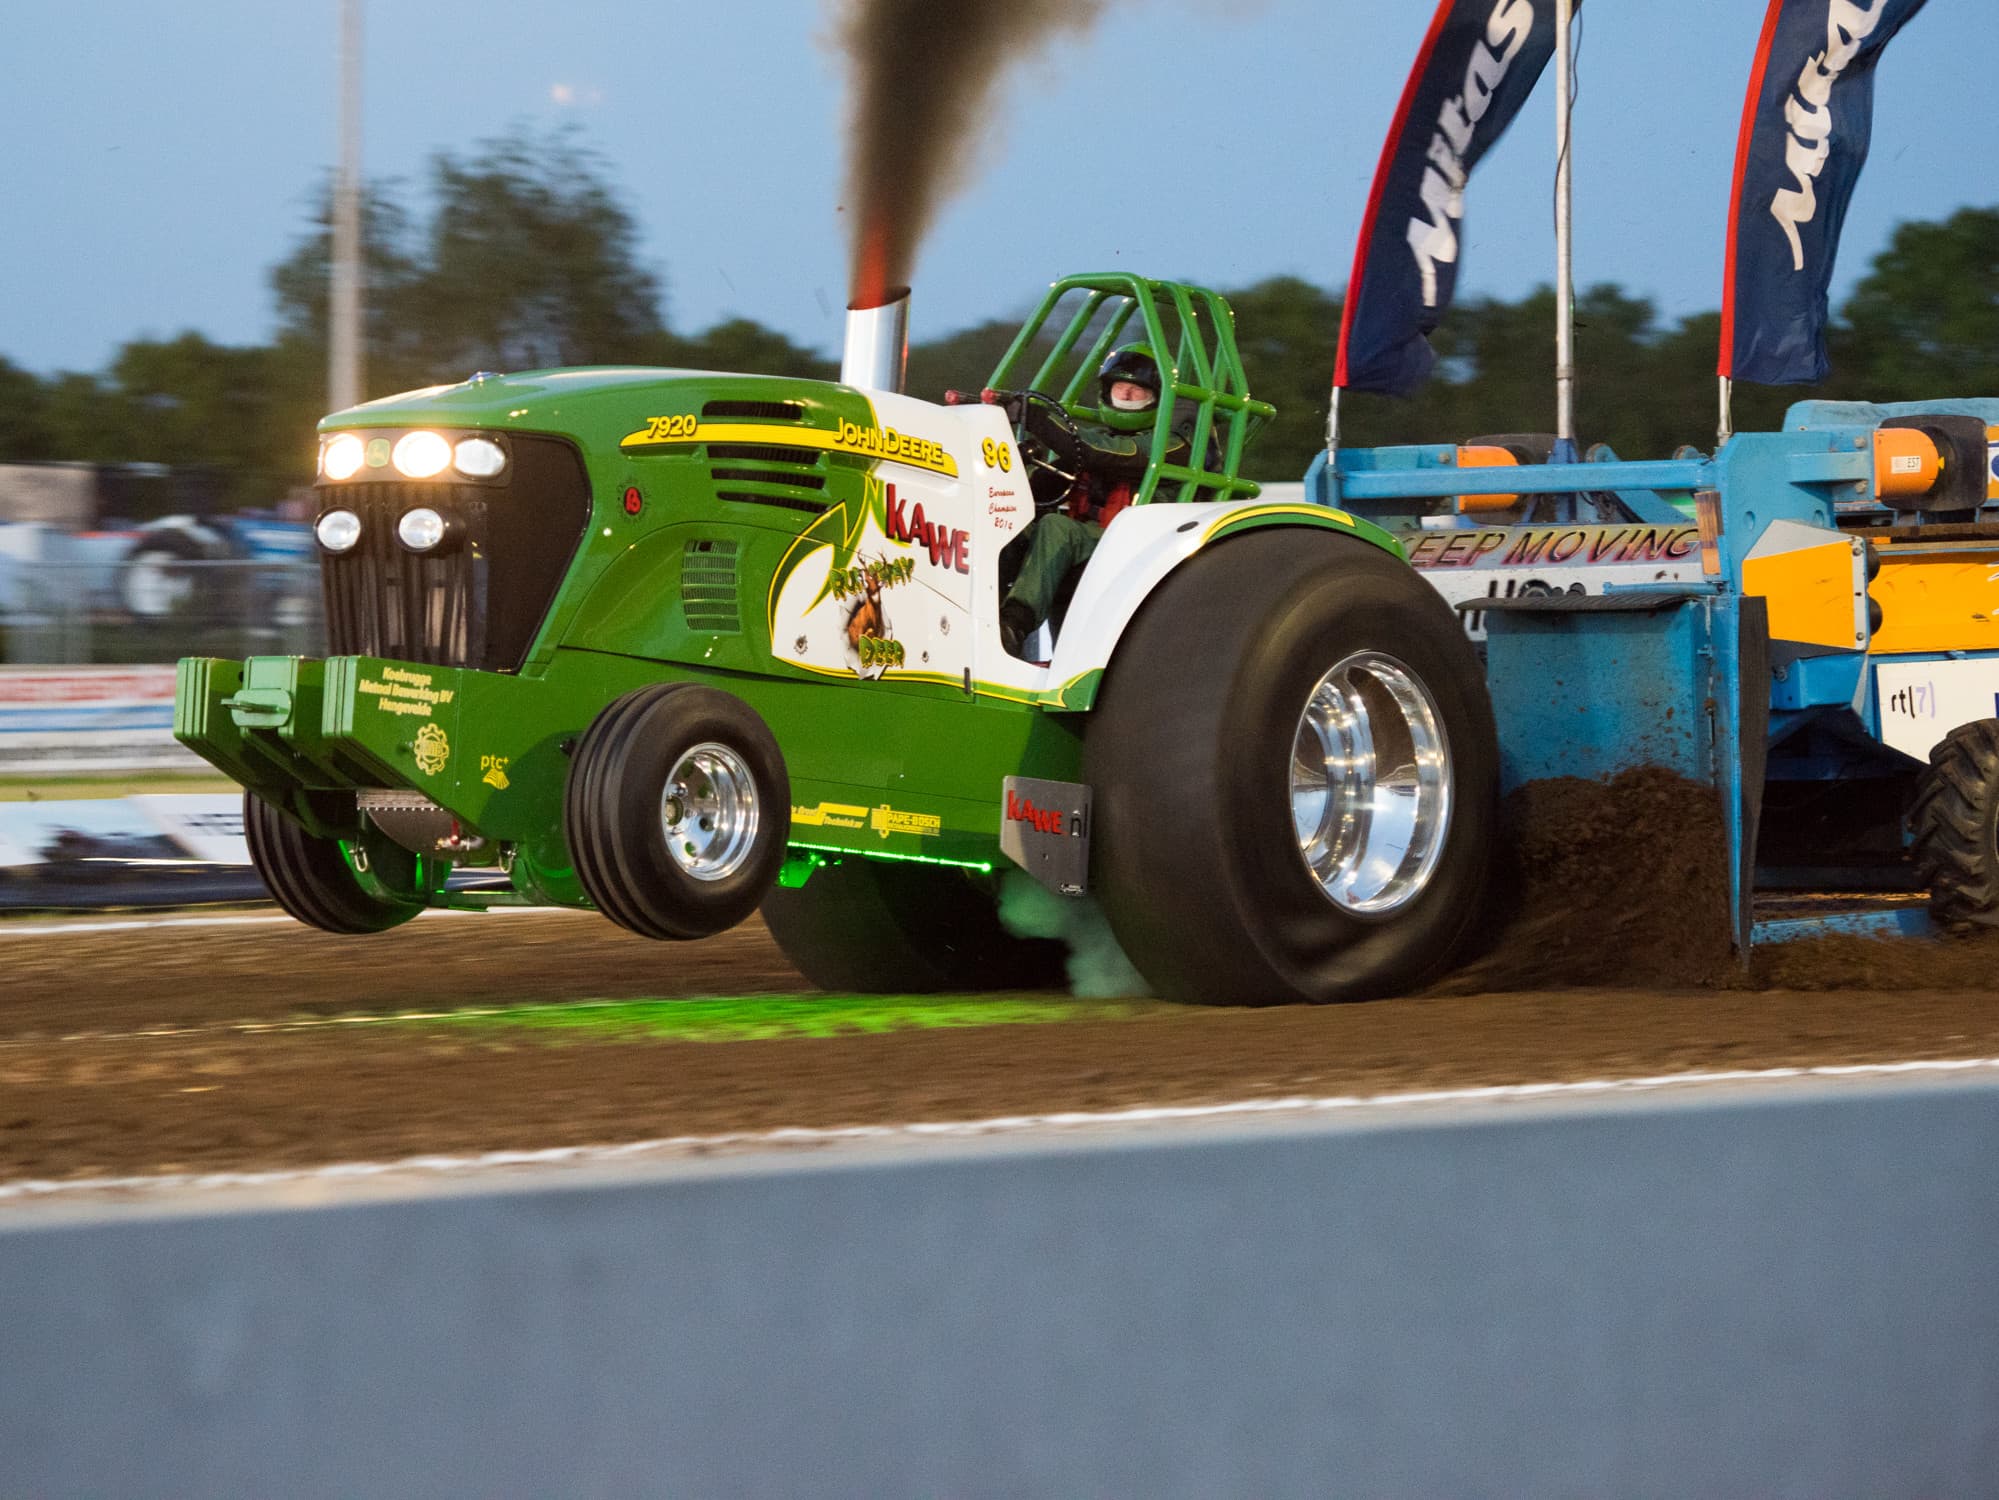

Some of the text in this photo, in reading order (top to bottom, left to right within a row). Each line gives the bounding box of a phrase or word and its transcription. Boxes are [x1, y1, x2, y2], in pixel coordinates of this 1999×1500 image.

[647, 414, 698, 439] 7920
[834, 416, 944, 466] JOHN DEERE
[982, 437, 1011, 473] 96
[1404, 527, 1699, 568] EEP MOVING
[859, 634, 906, 669] DEER
